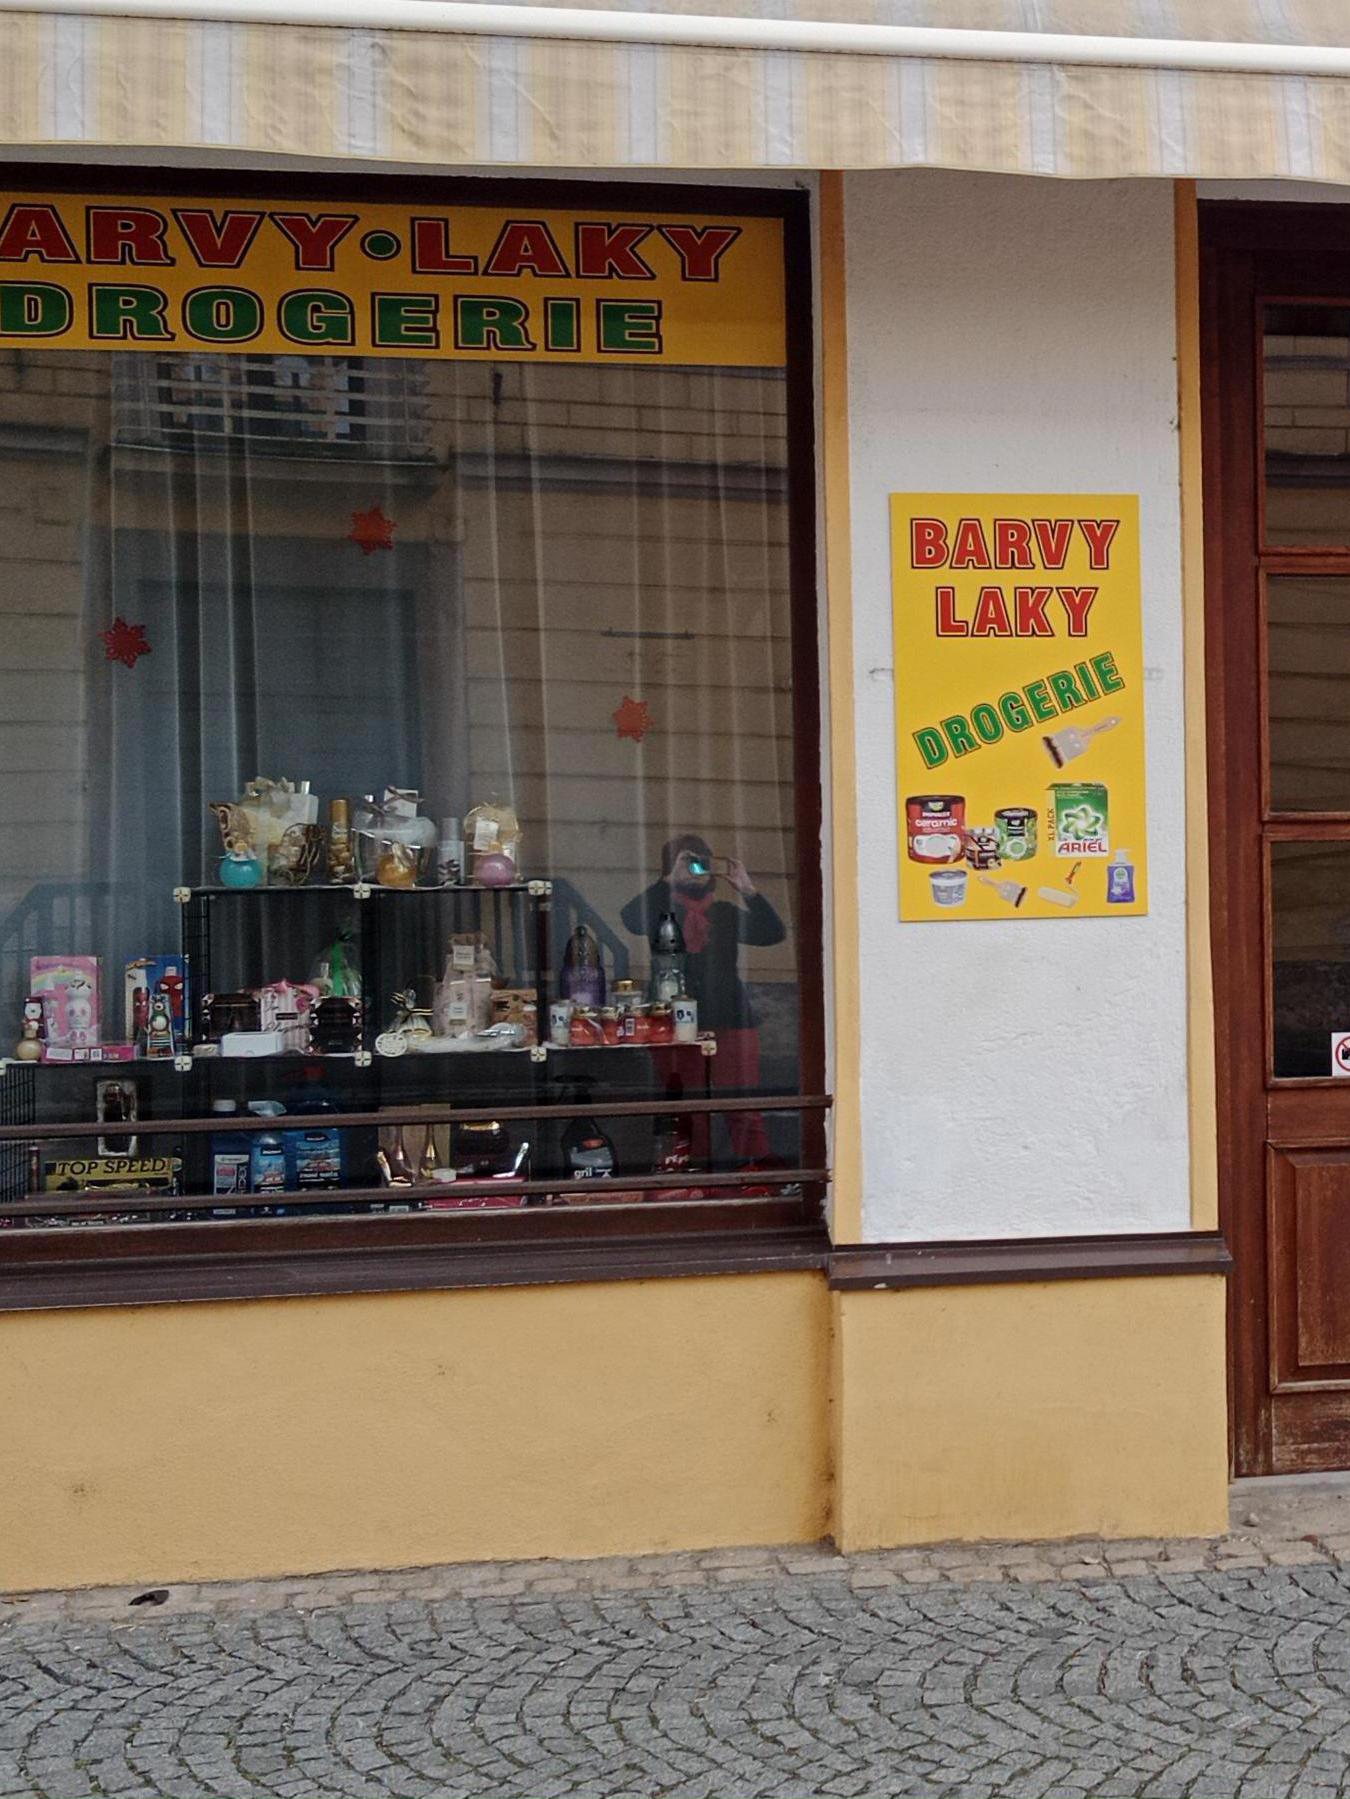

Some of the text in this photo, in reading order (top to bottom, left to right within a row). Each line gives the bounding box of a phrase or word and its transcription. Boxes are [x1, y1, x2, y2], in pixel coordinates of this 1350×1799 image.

[410, 217, 743, 282] LAKY
[0, 280, 663, 354] DROGERIE
[910, 517, 1120, 570] BARVY
[935, 586, 1099, 638] LAKY
[912, 651, 1126, 770] DROGERIE
[1058, 840, 1108, 853] ARIEL
[58, 1158, 167, 1176] TOP SPEED
